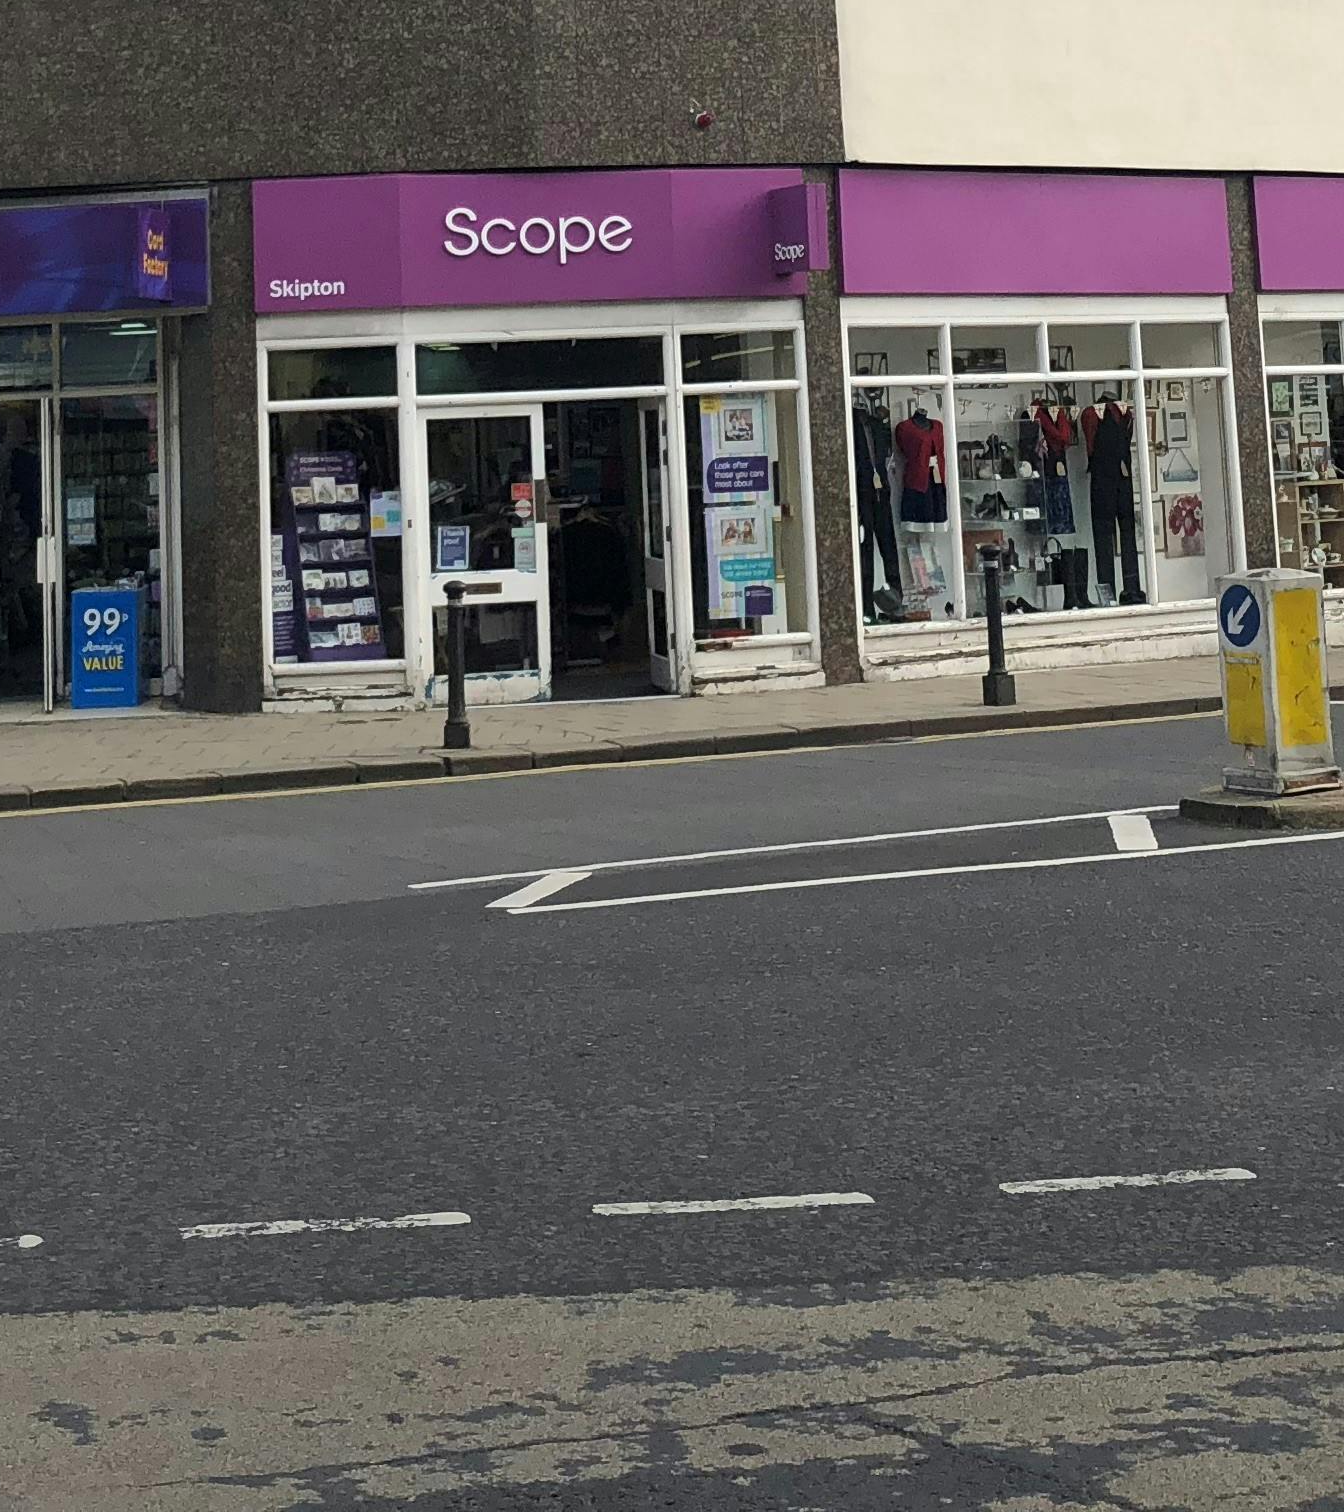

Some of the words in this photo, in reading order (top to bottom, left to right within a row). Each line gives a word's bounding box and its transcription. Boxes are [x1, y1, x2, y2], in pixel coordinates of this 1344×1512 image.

[147, 229, 164, 250] Card
[444, 207, 633, 264] Scope
[773, 243, 805, 263] Scope
[143, 253, 168, 281] Factory
[269, 279, 346, 301] Skipton
[271, 564, 284, 578] eel
[83, 655, 125, 671] VALUE
